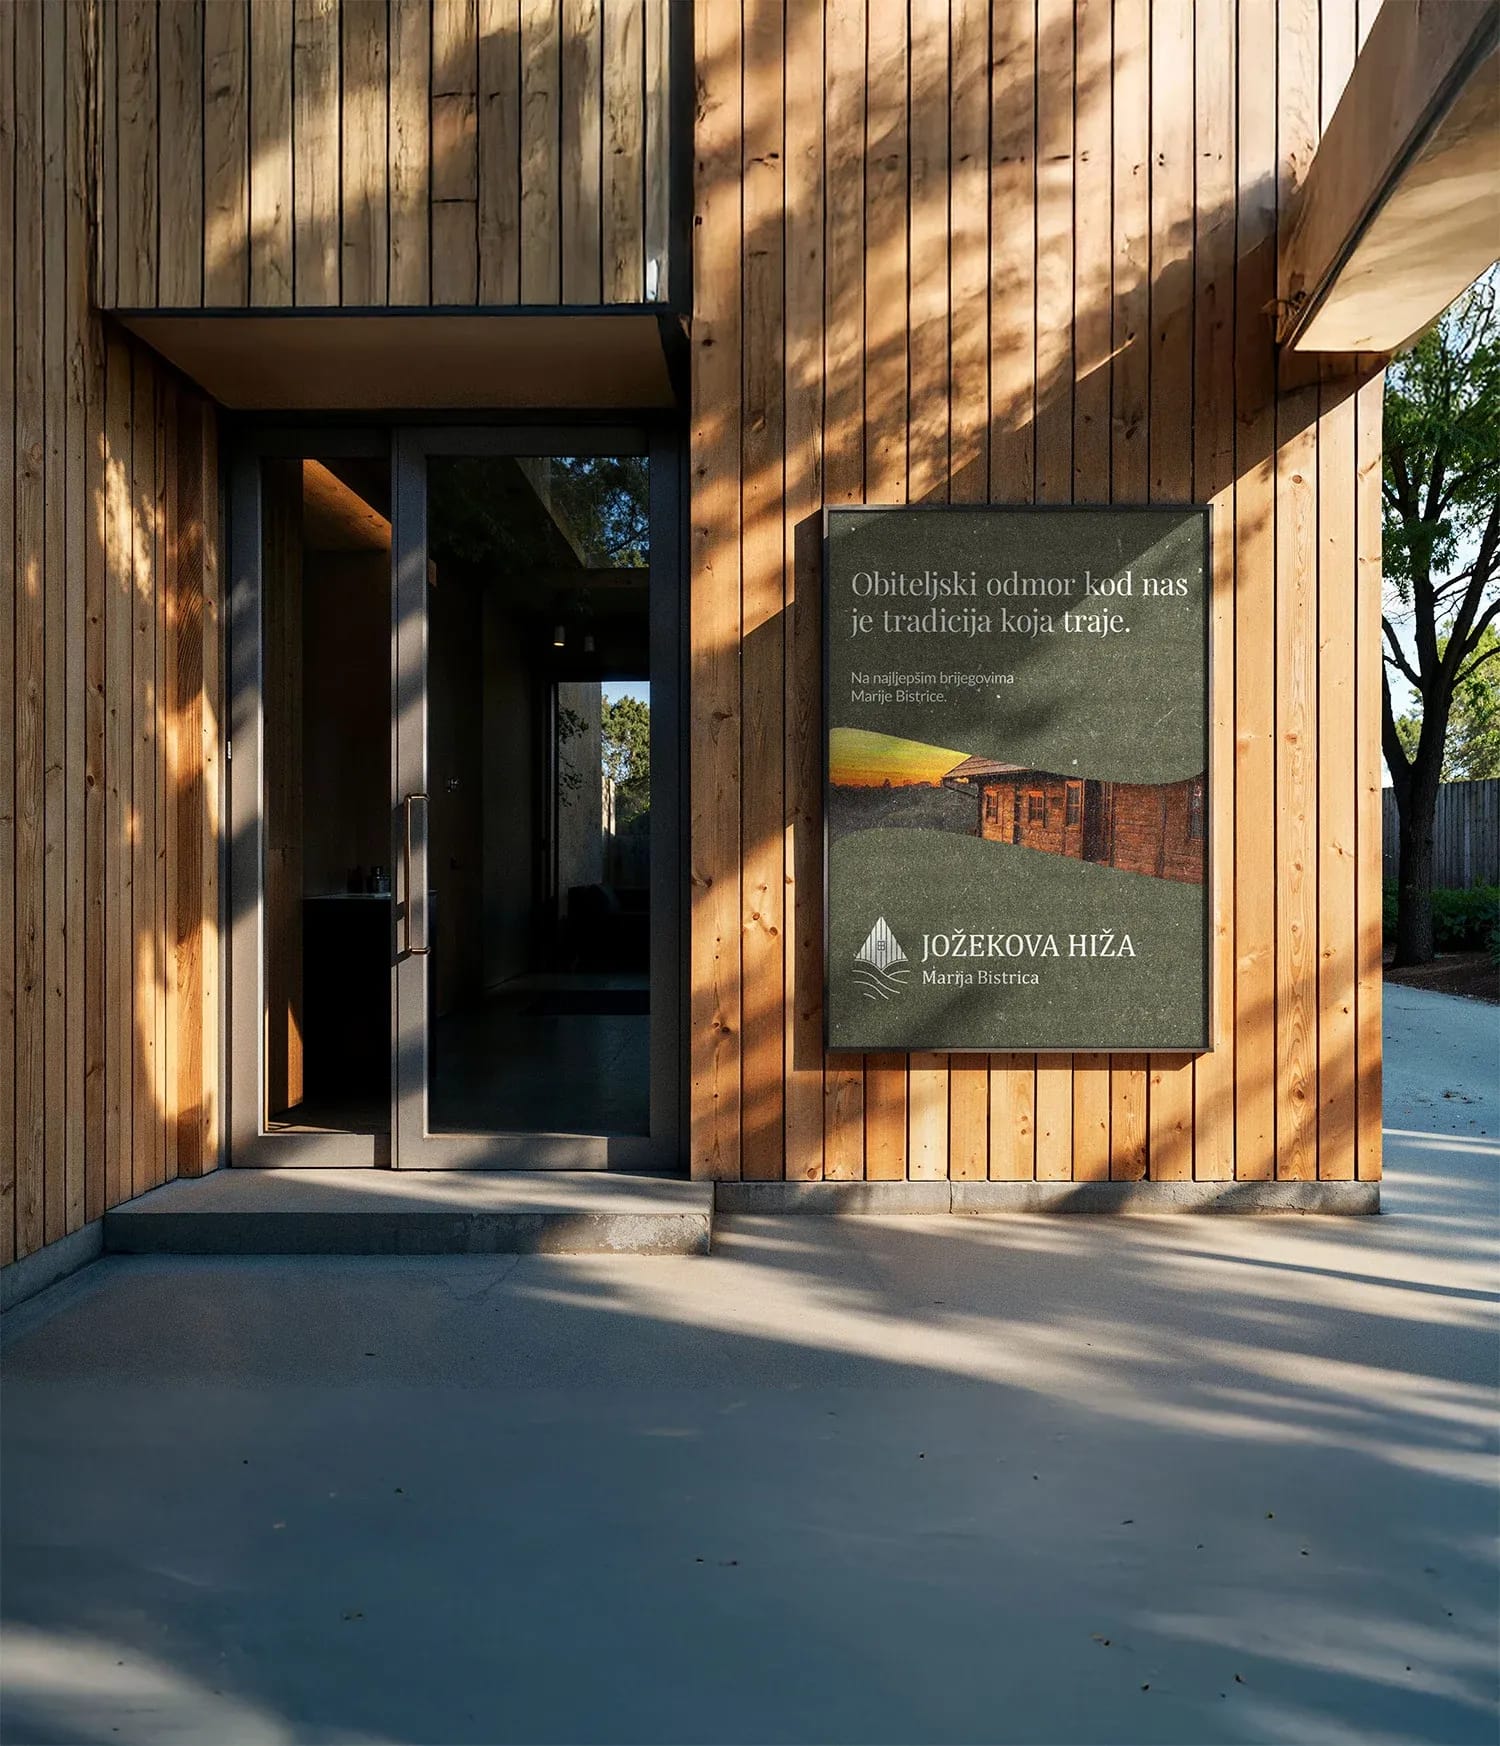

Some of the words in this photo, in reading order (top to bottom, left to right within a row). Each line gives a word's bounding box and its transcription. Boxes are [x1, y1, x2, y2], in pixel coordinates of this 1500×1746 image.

[852, 571, 977, 601] Obiteljski
[986, 571, 1076, 597] odmor
[1085, 571, 1133, 597] kod
[1142, 577, 1189, 597] nas
[850, 608, 873, 638] je
[883, 607, 992, 638] tradicija
[1001, 607, 1055, 638] koja
[1064, 608, 1131, 638] traje.
[851, 672, 870, 684] Na
[873, 671, 936, 688] najljepšim
[940, 671, 1014, 688] brijegovima
[851, 690, 893, 705] Marije
[896, 690, 947, 702] Bistrice.
[920, 928, 1061, 963] JOŽEKOVA
[1068, 928, 1136, 957] HIŽA
[922, 970, 974, 988] Marija
[977, 970, 1039, 985] Bistrica
